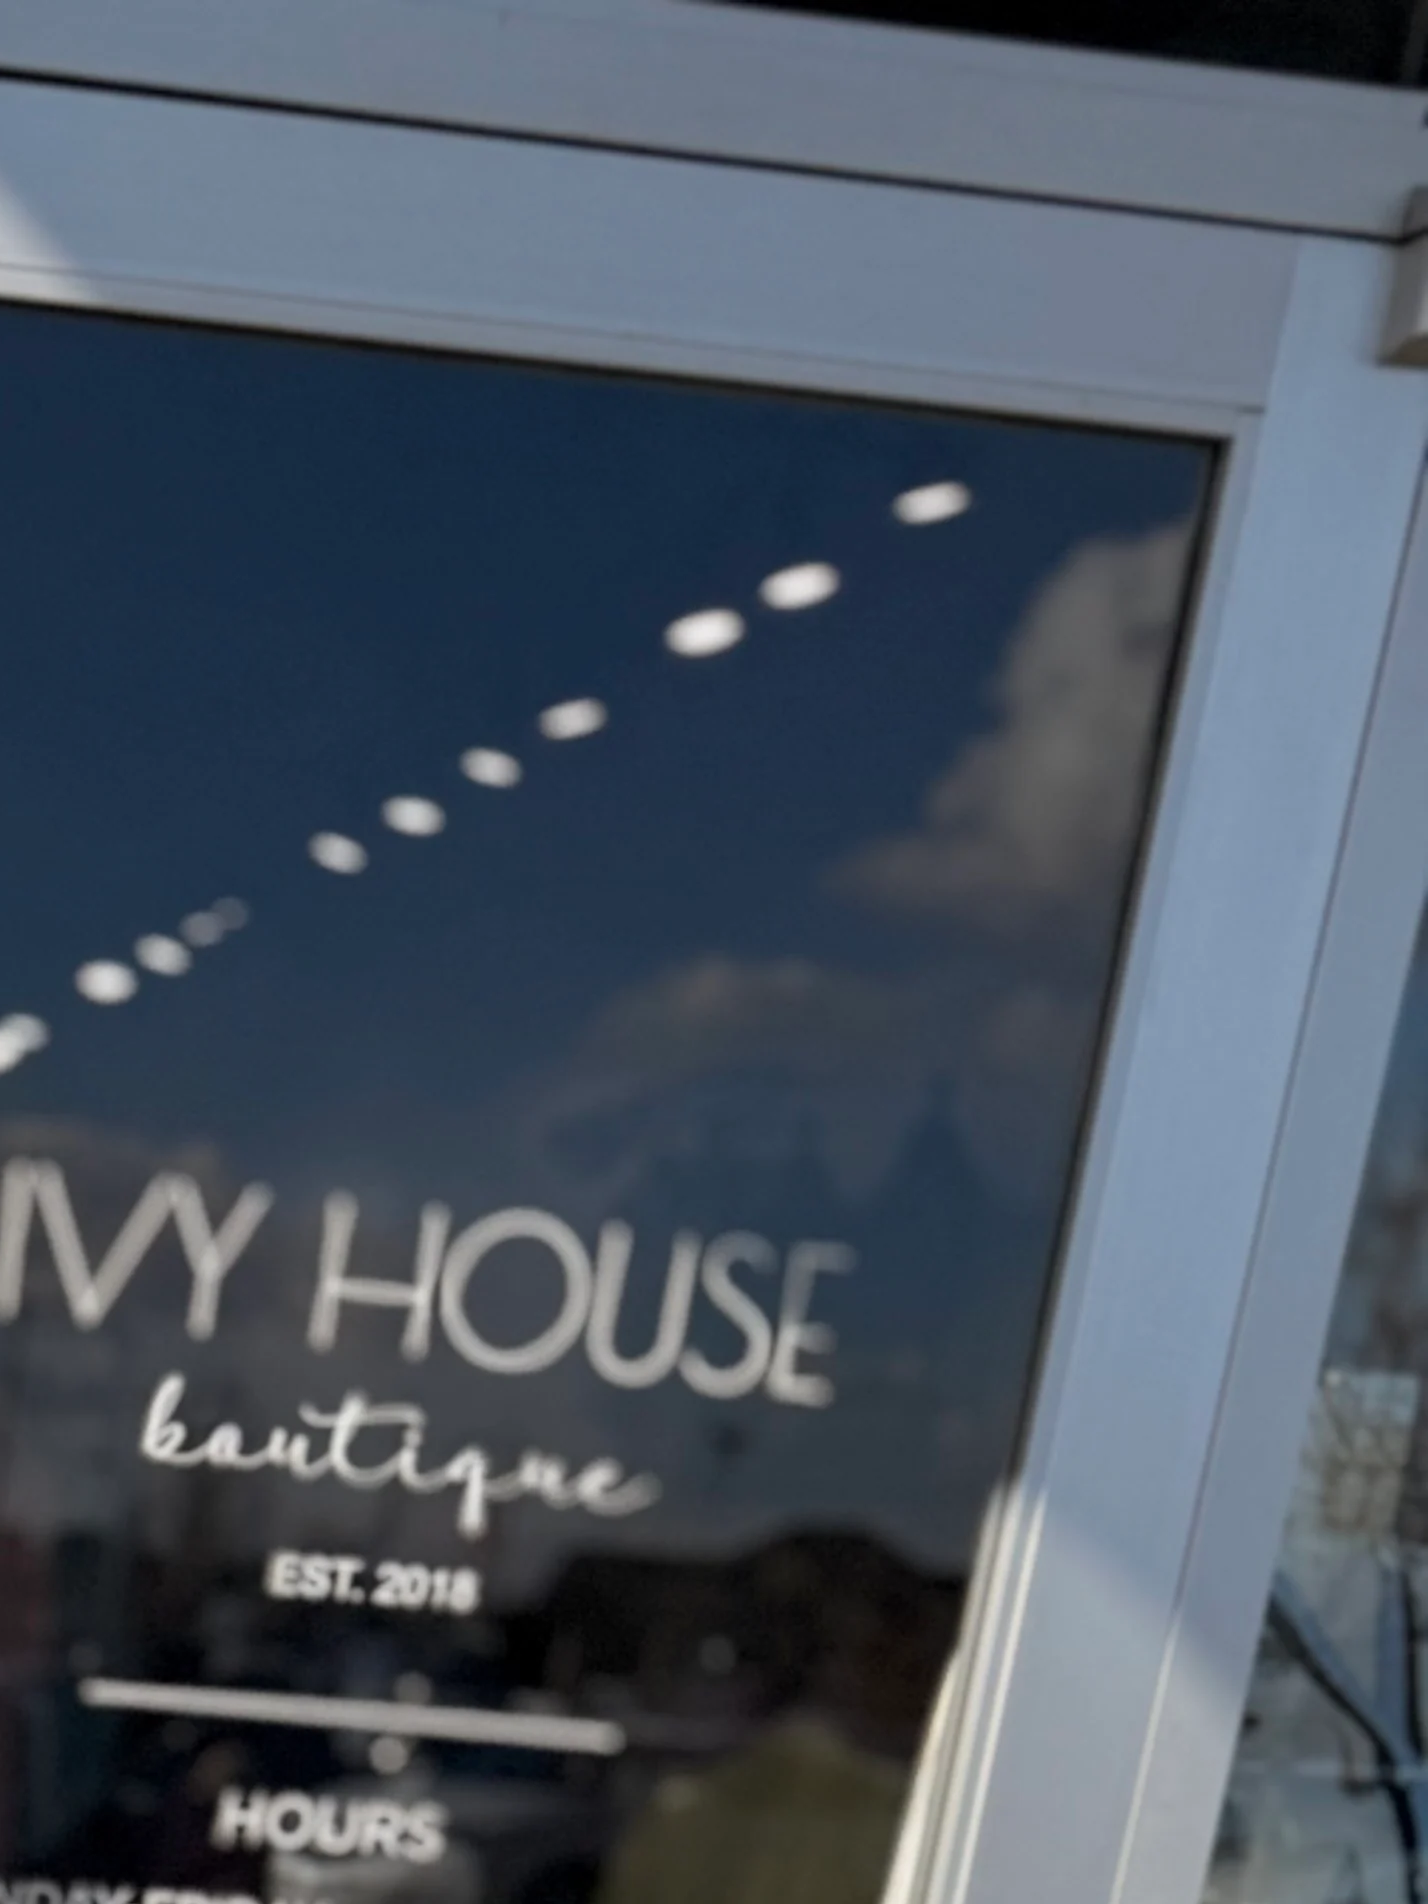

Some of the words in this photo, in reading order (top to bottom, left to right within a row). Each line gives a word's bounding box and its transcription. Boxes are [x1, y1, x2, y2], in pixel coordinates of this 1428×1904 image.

[307, 1190, 858, 1407] HOUSE
[142, 1372, 660, 1538] boutique
[264, 1549, 366, 1605] EST.
[369, 1560, 482, 1615] 2018
[210, 1786, 450, 1864] HOURS
